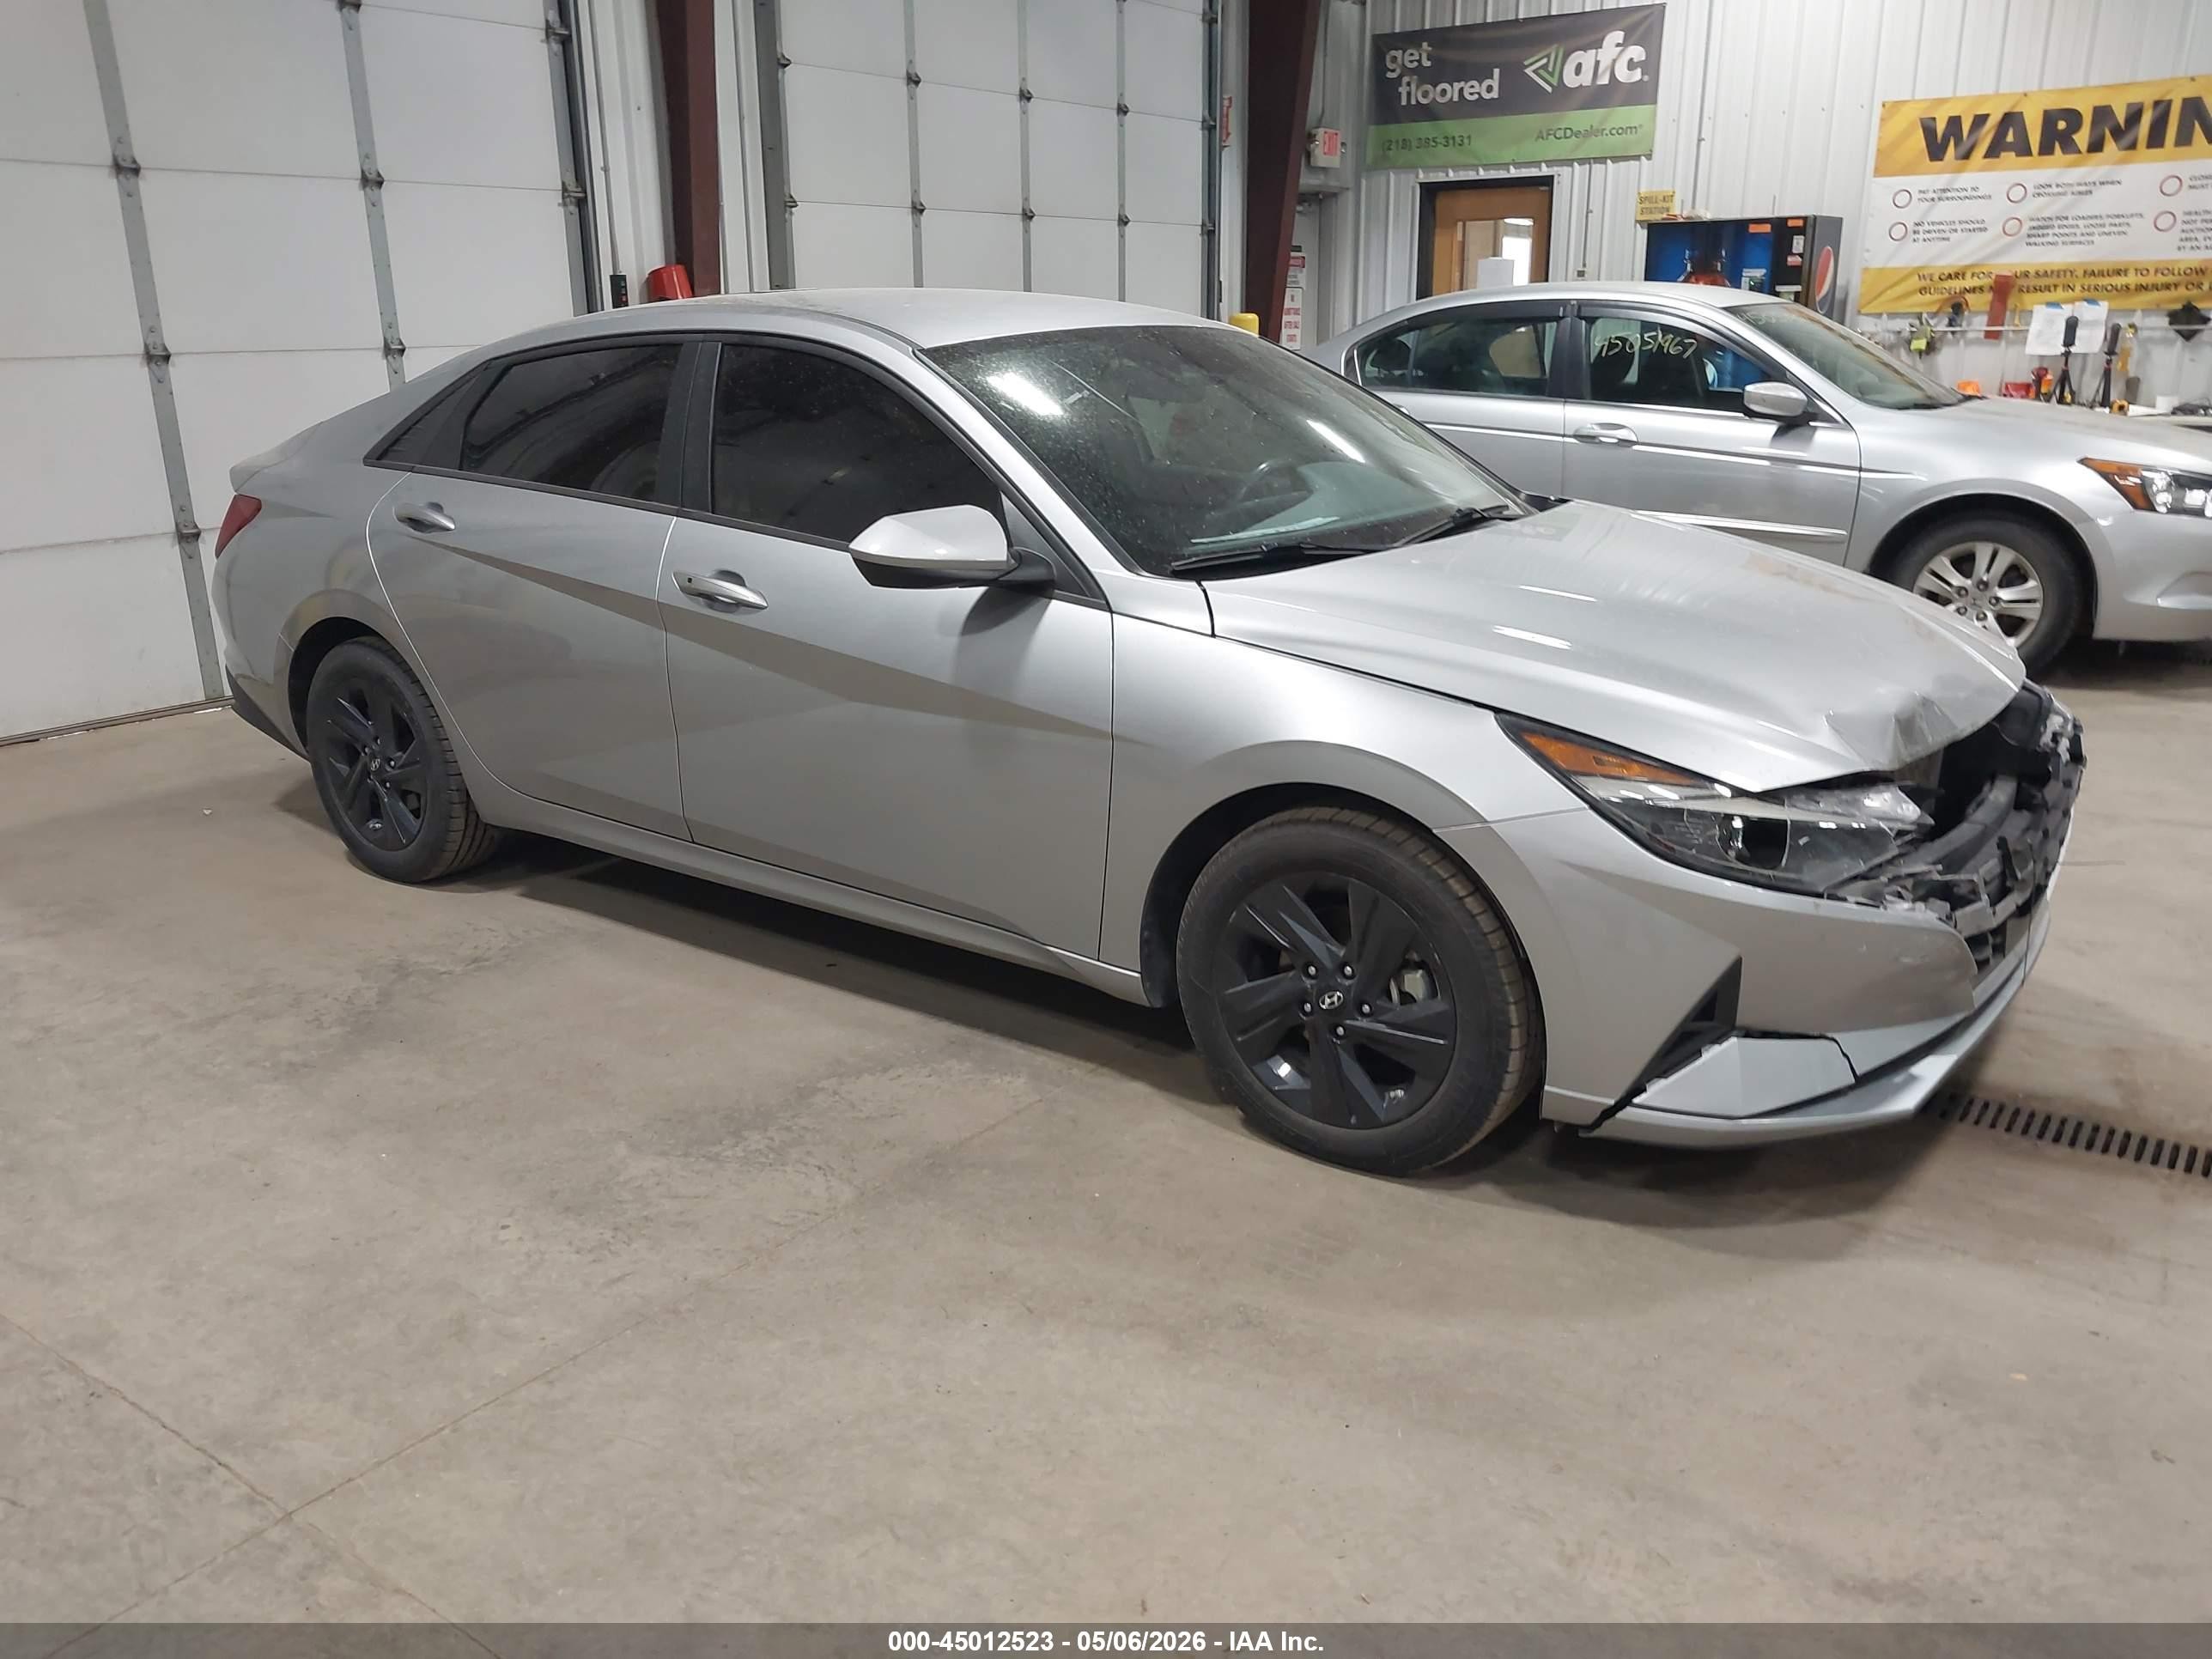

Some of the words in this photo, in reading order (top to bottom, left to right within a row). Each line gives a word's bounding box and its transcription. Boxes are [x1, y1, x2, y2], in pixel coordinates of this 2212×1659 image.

[1385, 42, 1432, 79] get
[1562, 30, 1646, 88] afc
[1398, 68, 1499, 106] floored
[1920, 95, 2212, 162] WARNIN
[1917, 272, 1934, 283] WE
[1938, 271, 1967, 282] CARE
[1971, 270, 1993, 281] FOR
[2082, 267, 2130, 278] FAILURE
[2135, 267, 2150, 276] TO
[2154, 265, 2207, 276] FOLLOW
[1918, 285, 1985, 295] GUIDELINES
[2018, 283, 2059, 294] RESULT
[2062, 283, 2075, 293] IN
[2080, 282, 2130, 293] SERIOUS
[2135, 281, 2179, 293] INJURY
[2185, 281, 2204, 291] OR
